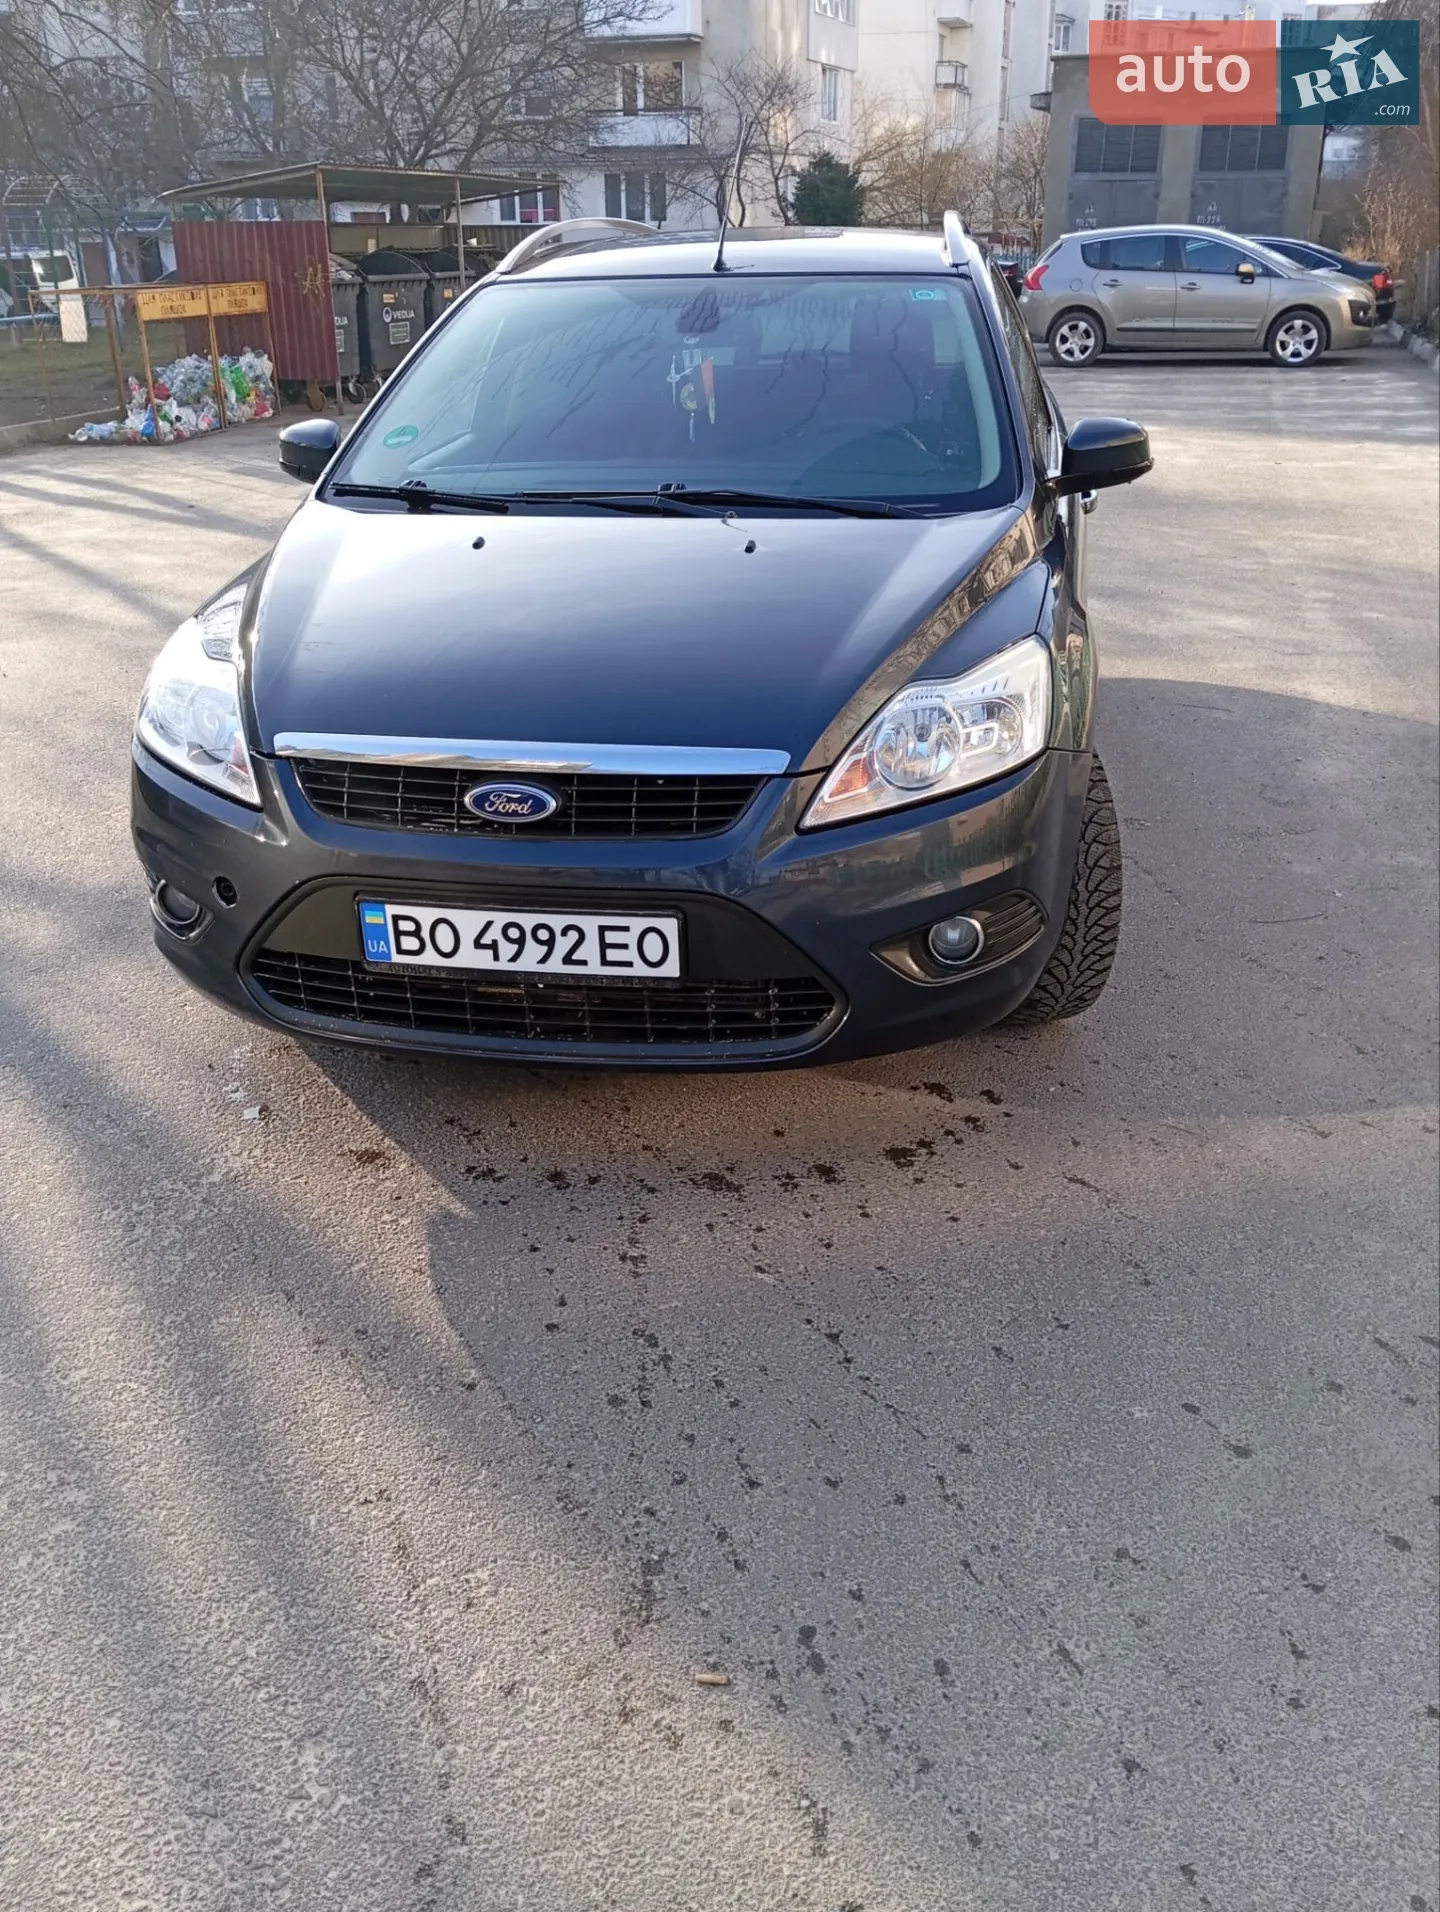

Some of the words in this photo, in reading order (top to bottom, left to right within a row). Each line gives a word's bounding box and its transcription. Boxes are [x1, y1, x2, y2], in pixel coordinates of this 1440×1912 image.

[392, 309, 415, 319] VEOLIA
[484, 791, 532, 815] Ford
[368, 939, 388, 954] UA
[473, 919, 588, 966] 4992
